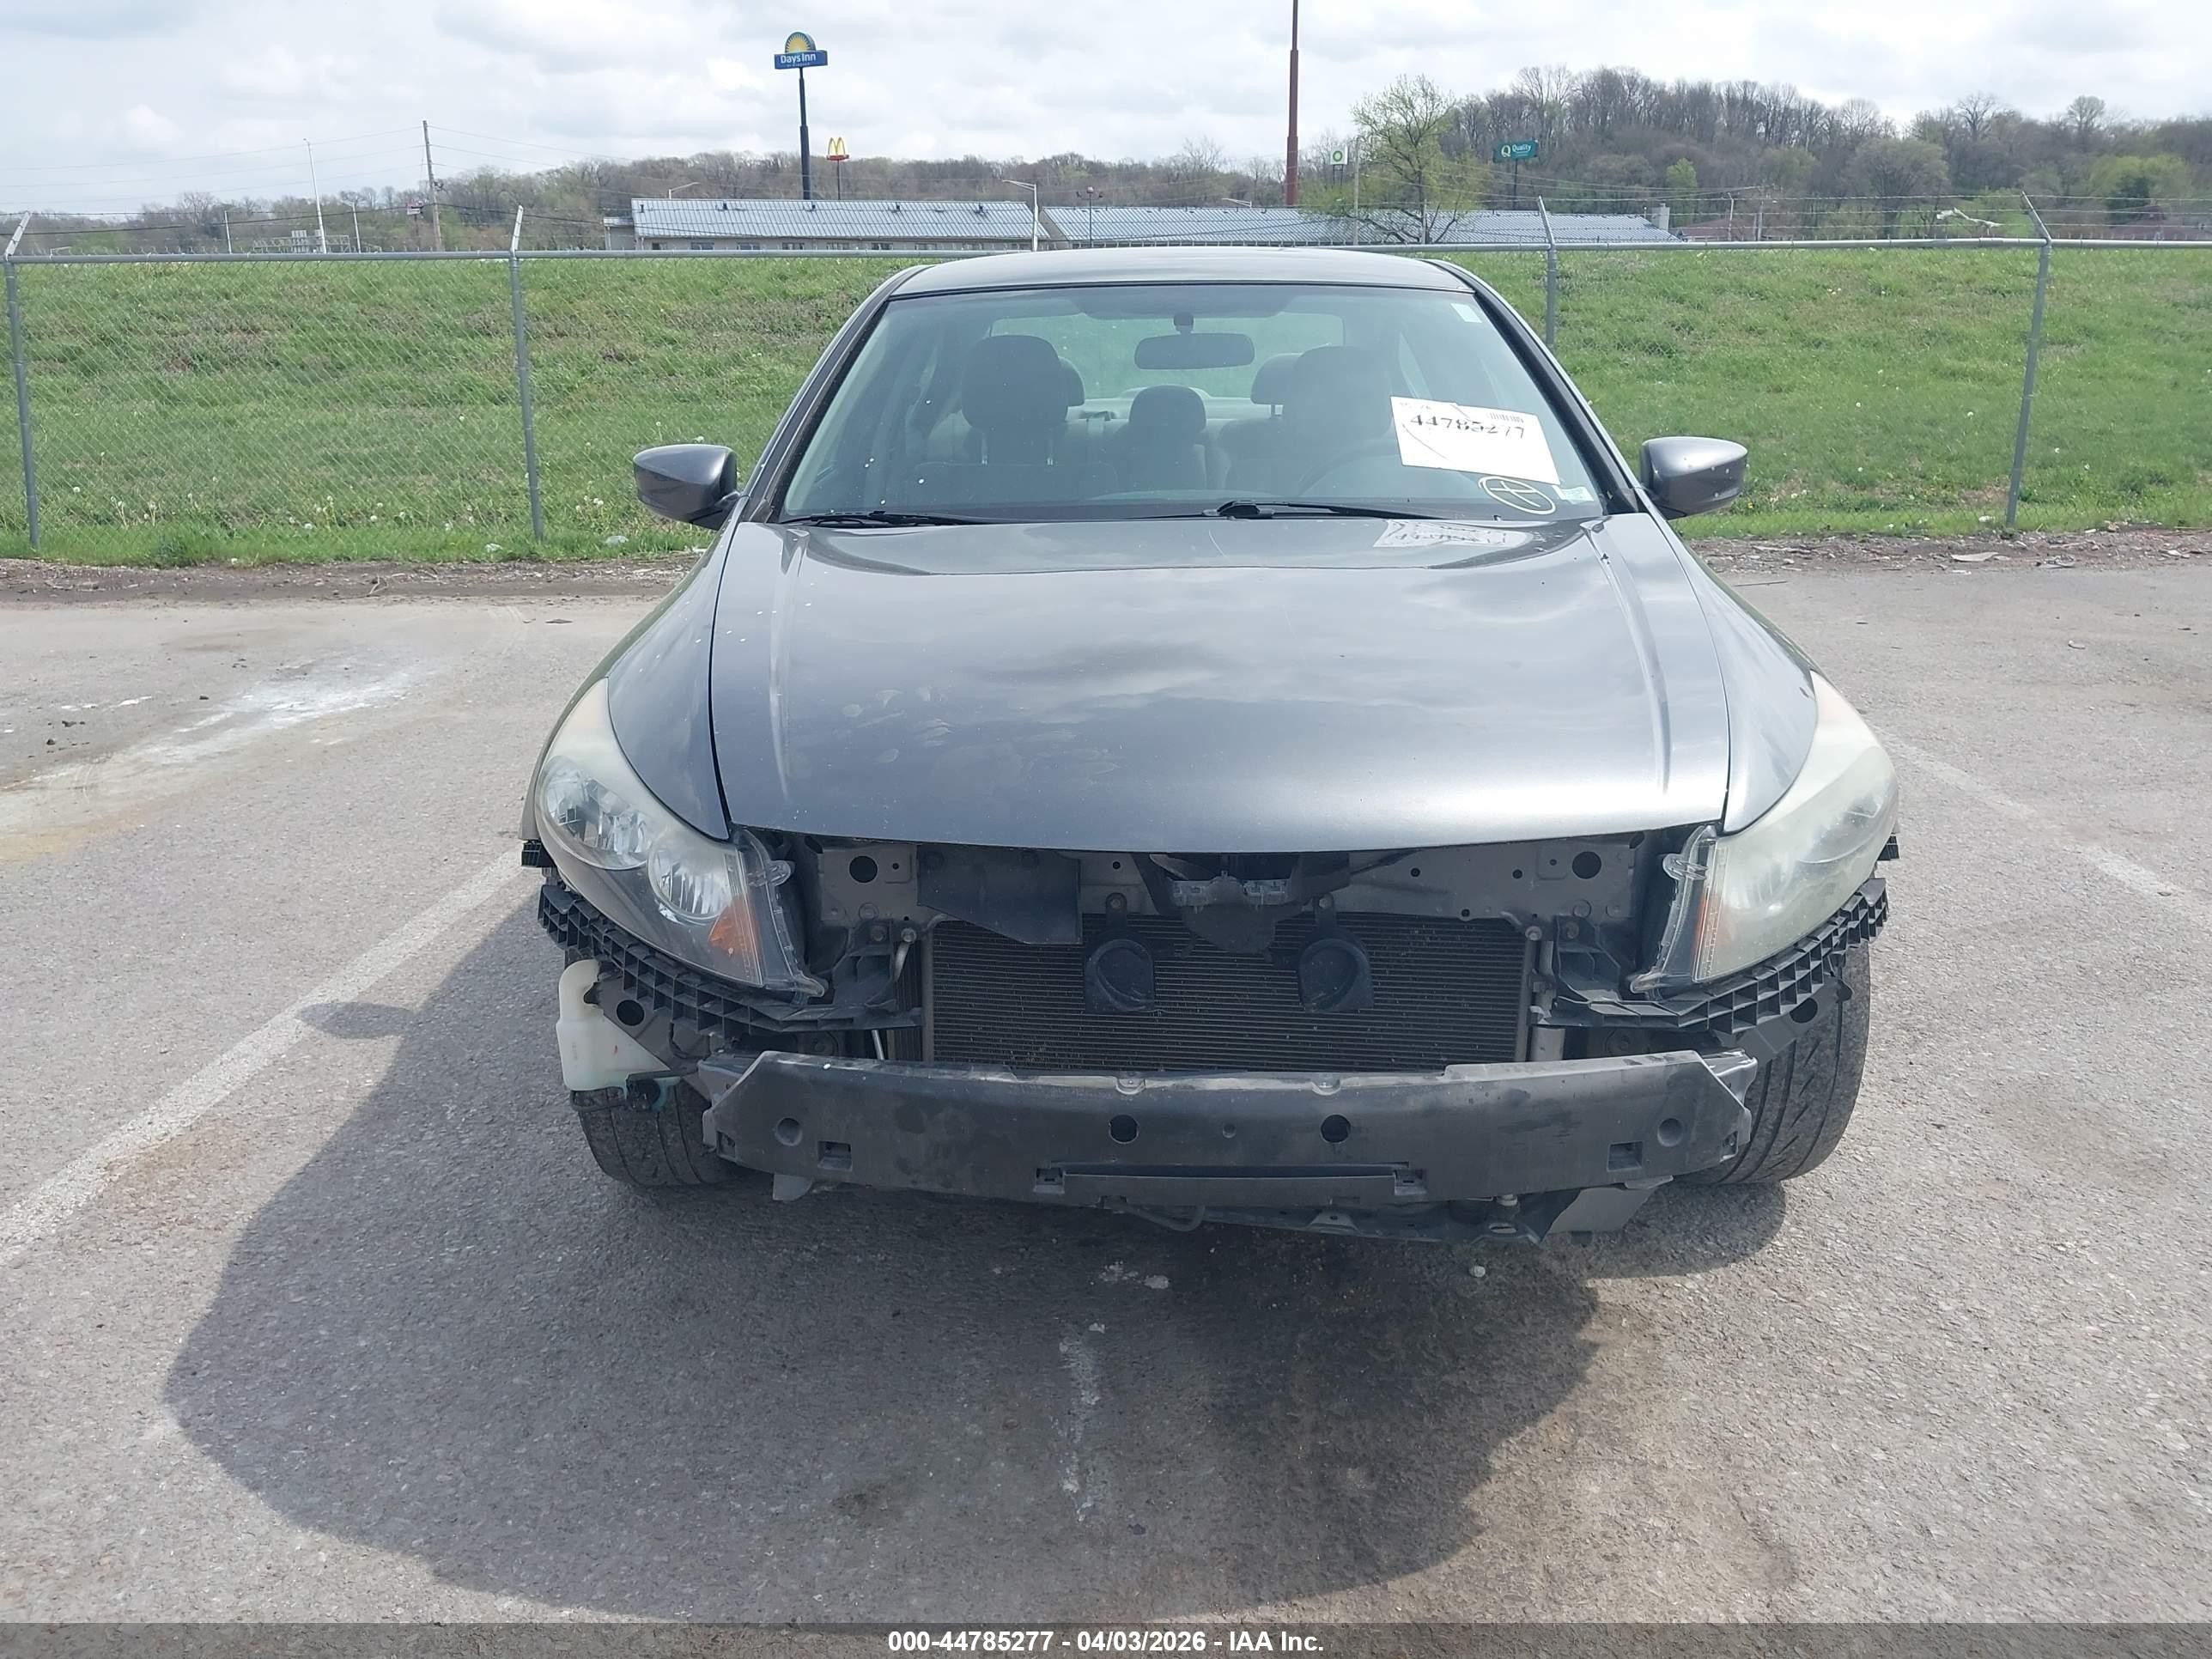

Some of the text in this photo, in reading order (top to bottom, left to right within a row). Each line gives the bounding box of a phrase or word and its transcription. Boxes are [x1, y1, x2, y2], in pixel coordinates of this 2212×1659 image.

[781, 53, 817, 64] Days Inn
[1511, 143, 1532, 152] Quality
